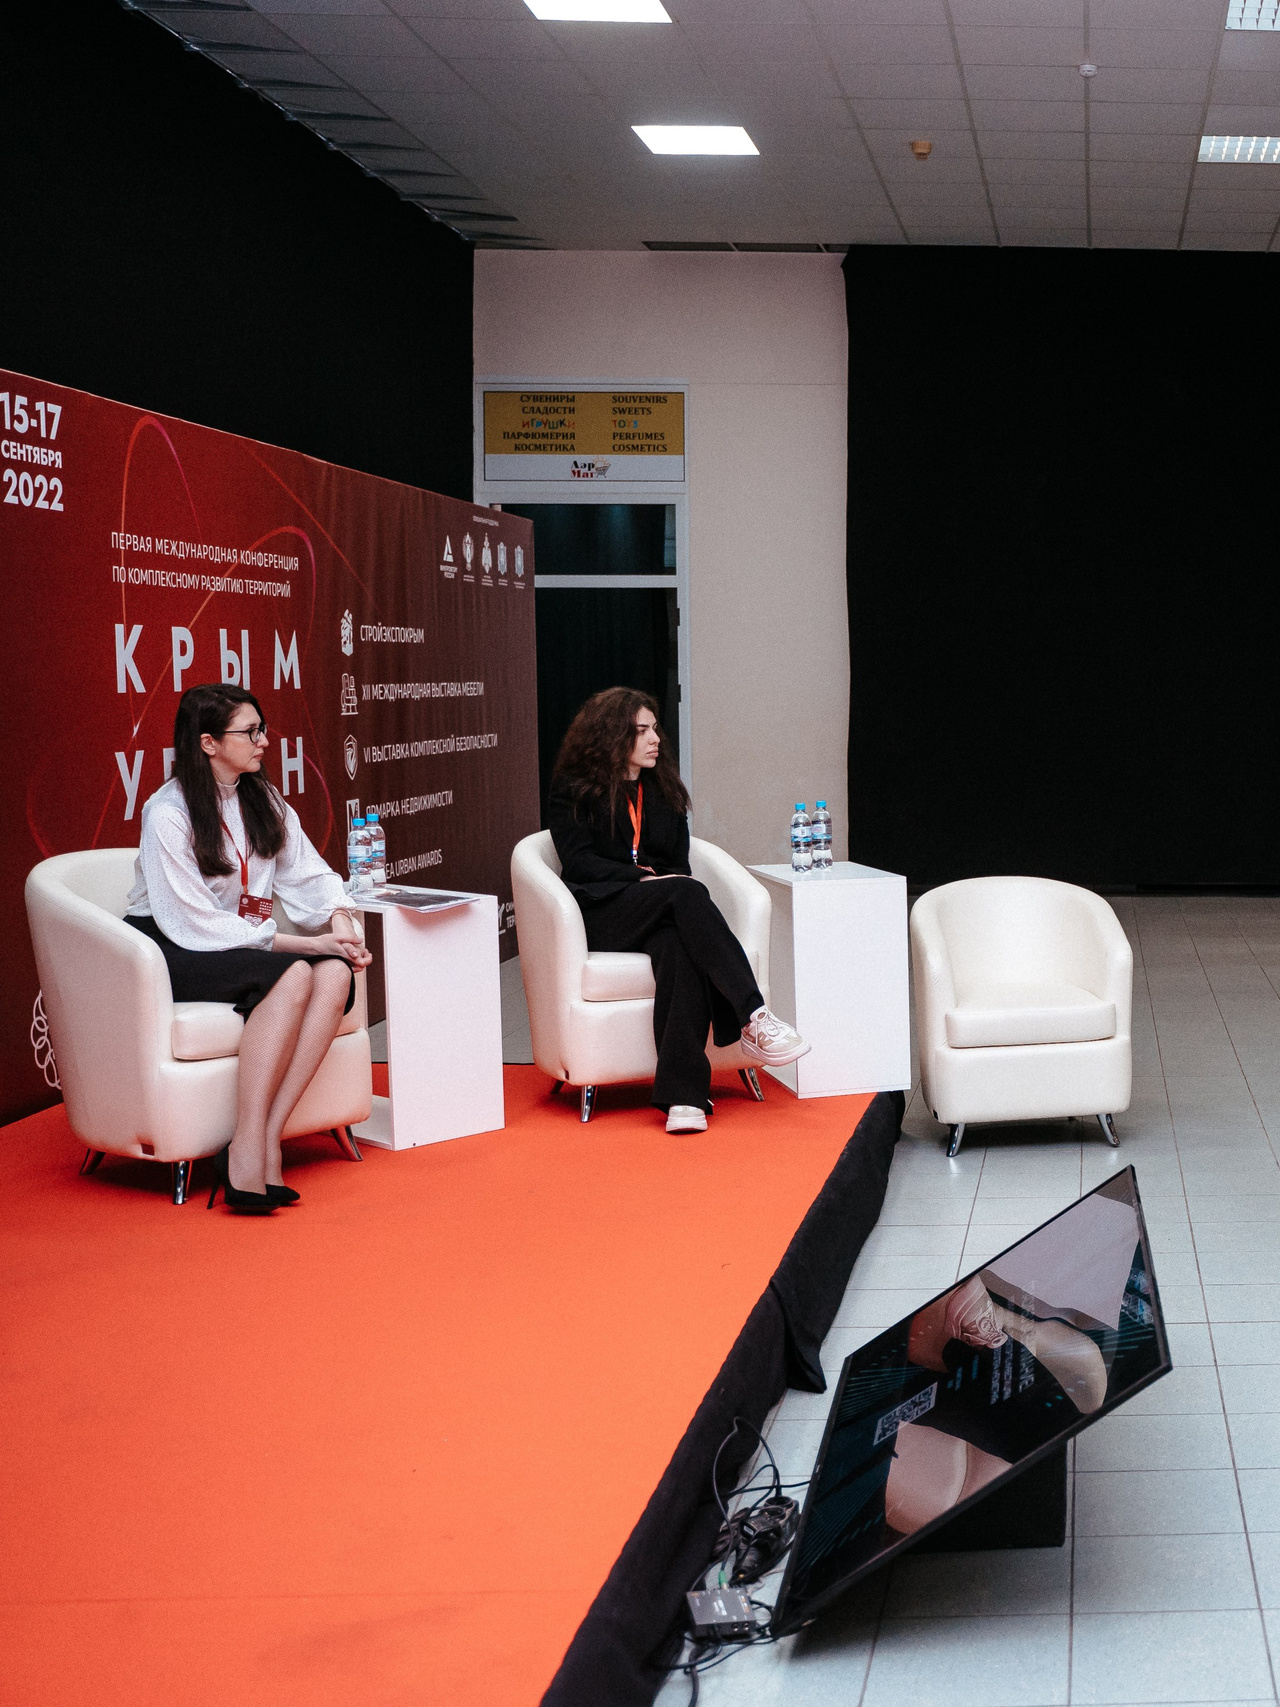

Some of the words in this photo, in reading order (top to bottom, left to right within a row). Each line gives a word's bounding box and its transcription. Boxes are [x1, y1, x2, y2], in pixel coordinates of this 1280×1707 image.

[520, 395, 575, 403] СУВЕНИРЫ
[612, 395, 668, 404] SOUVENIRS
[0, 391, 62, 440] 15-17
[522, 406, 575, 415] СЛАДОСТИ
[612, 407, 652, 415] SWEETS
[503, 432, 576, 440] ПАРФЮМЕРИЯ
[612, 432, 665, 440] PERFUMES
[1, 440, 62, 468] СЕНТЯБРЯ
[514, 443, 576, 452] КОСМЕТИКА
[612, 443, 668, 452] COSMETICS
[3, 469, 64, 511] 2022
[111, 532, 152, 553] ПЕРВАЯ
[155, 537, 238, 564] МЕЖДУНАРОДНАЯ
[240, 549, 299, 572] КОНФЕРЕНЦИЯ
[112, 566, 126, 583] ПО
[128, 567, 200, 589] КОМПЛЕКСНОМУ
[201, 575, 243, 594] РАЗВИТИЮ
[244, 579, 291, 598] ТЕРРИТОРИЙ
[360, 622, 425, 643] СТРОЙЭКСПОКРЫМ
[361, 684, 371, 700] XII
[371, 683, 431, 701] МЕЖДУНАРОДНАЯ
[432, 682, 461, 698] ВЫСТАВКА
[363, 746, 371, 763] VI
[372, 744, 409, 763] ВЫСТАВКА
[410, 734, 456, 758] КОМПЛЕКСНОЙ
[456, 733, 498, 752] БЕЗОПАСНОСТИ
[401, 790, 453, 815] НЕДВИЖИМОСТИ
[395, 854, 417, 877] URBAN
[417, 849, 443, 869] AWARDS
